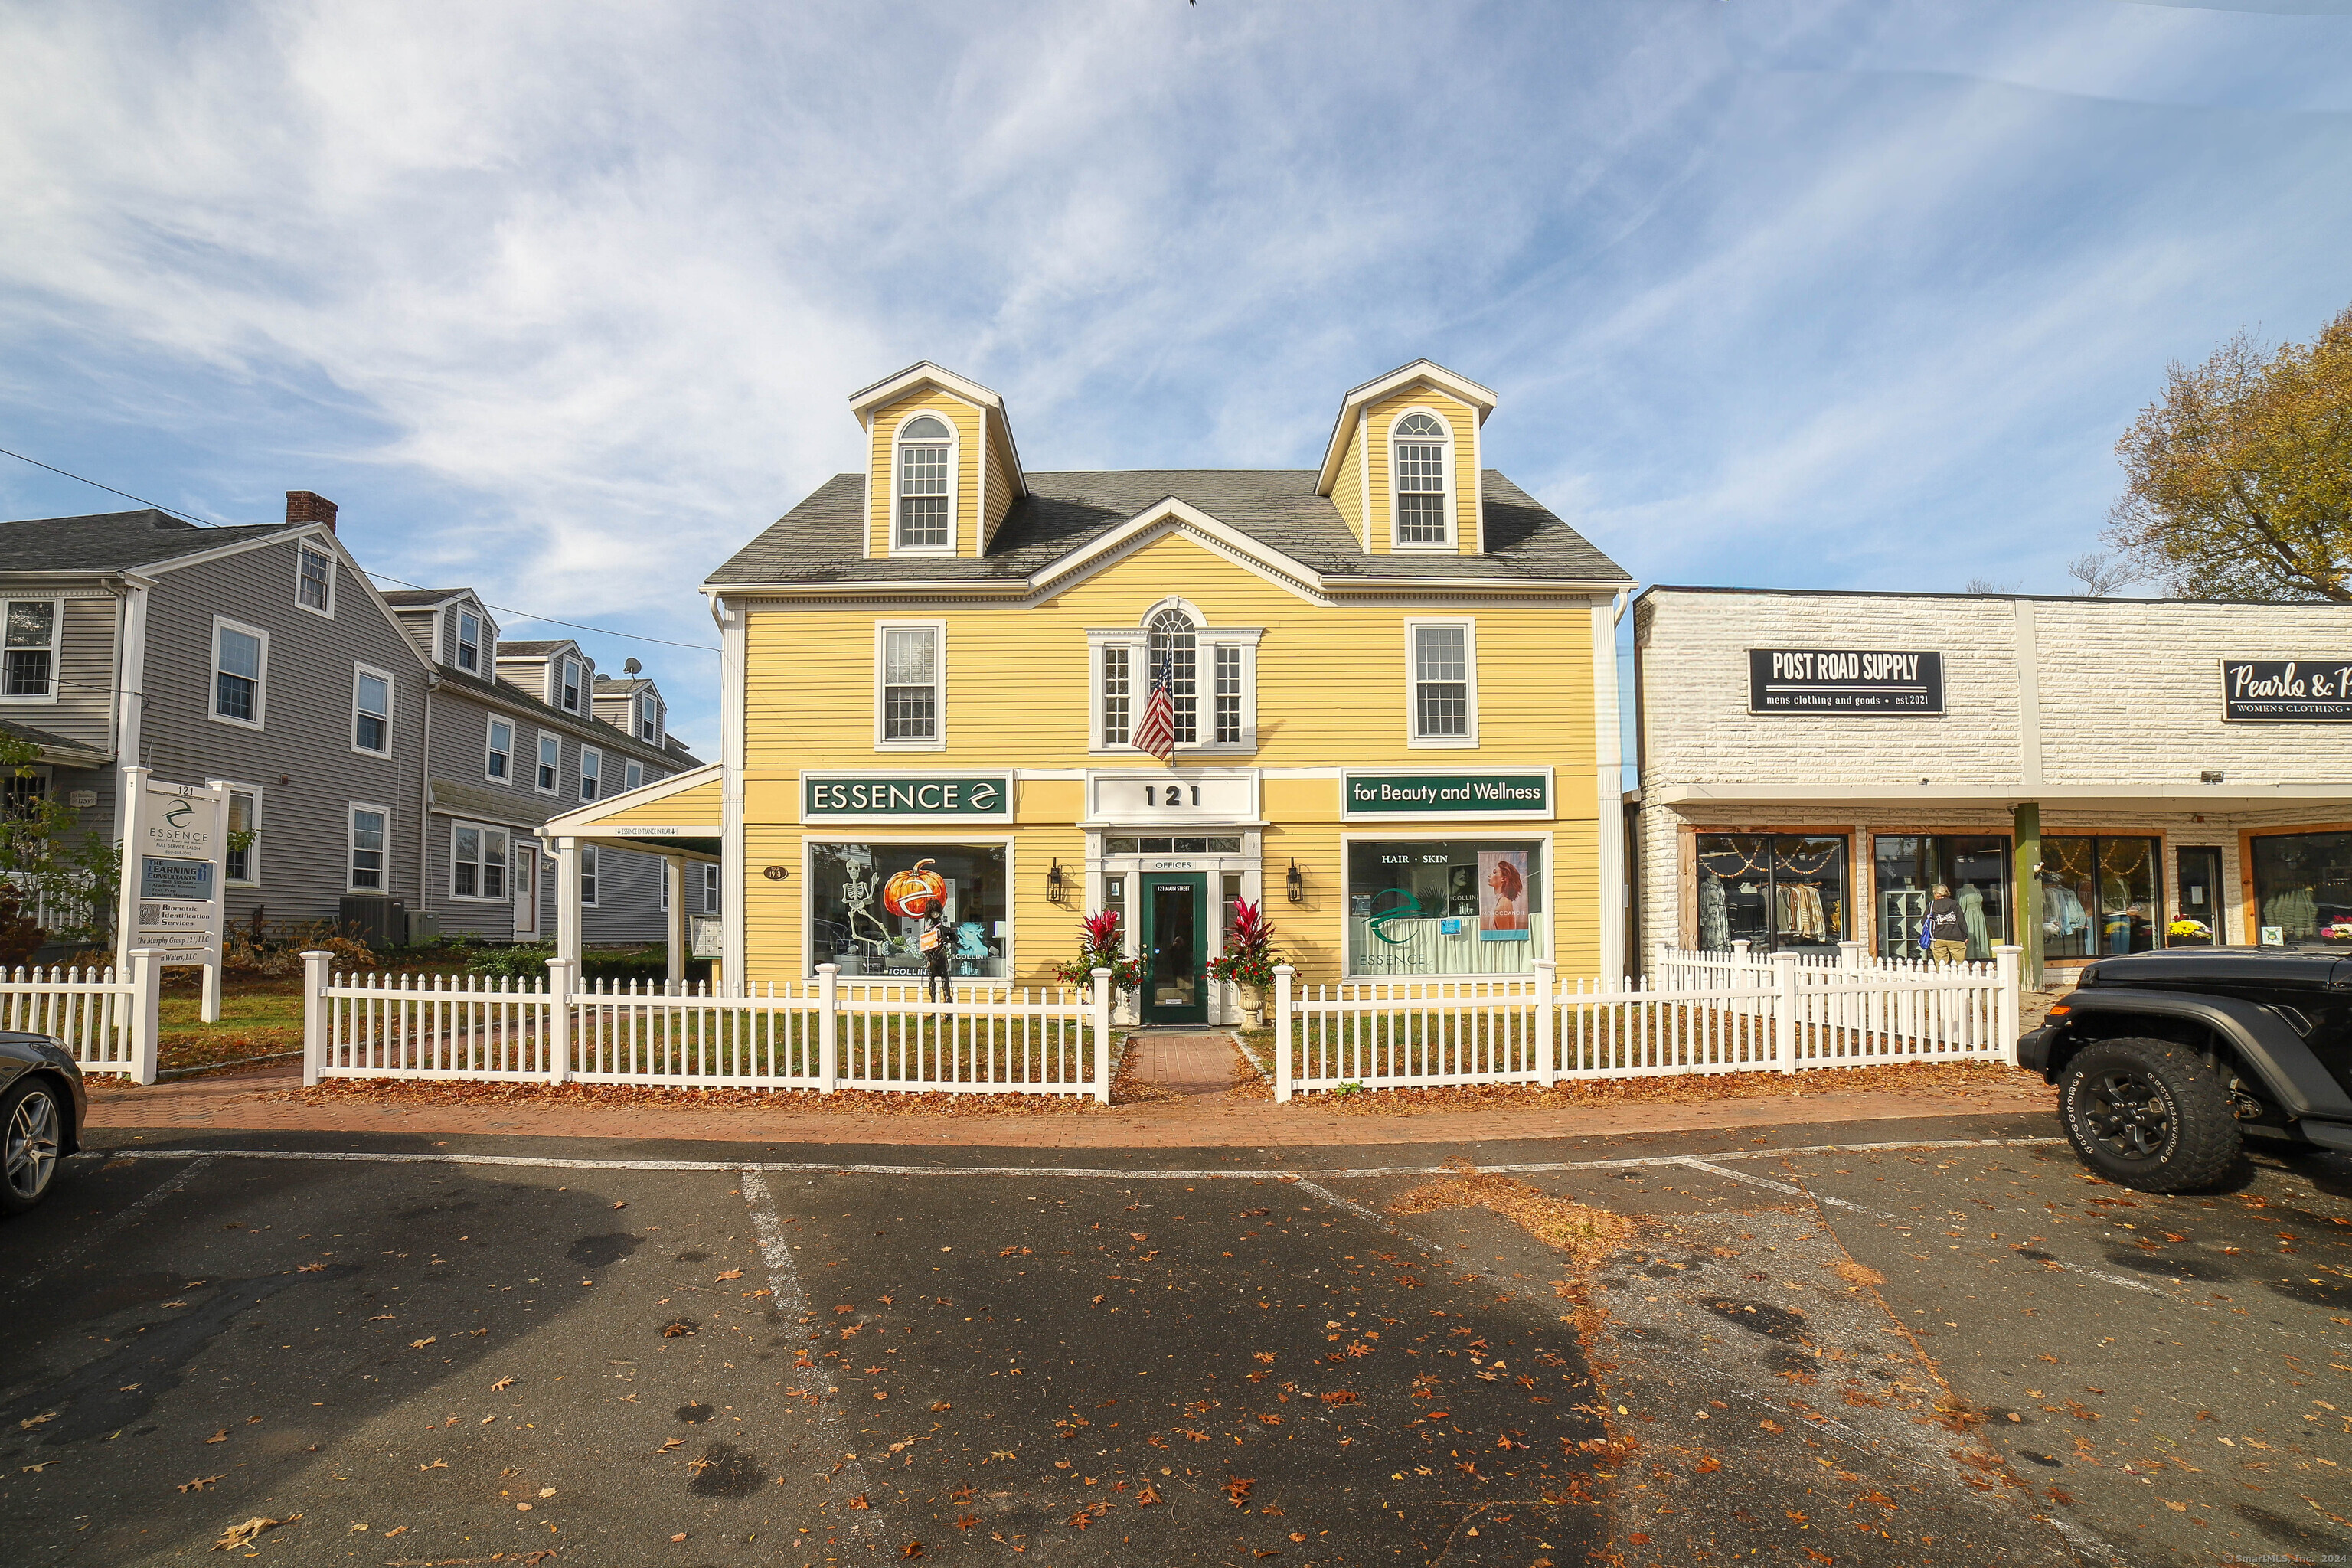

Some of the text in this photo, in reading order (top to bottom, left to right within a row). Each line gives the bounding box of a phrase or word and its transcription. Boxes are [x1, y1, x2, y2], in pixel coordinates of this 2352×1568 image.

[1772, 652, 1919, 681] POST ROAD SUPPLY
[2230, 662, 2307, 698] Pearls
[2311, 673, 2334, 697] &
[1766, 696, 1791, 705] mens
[1793, 694, 1832, 707] clothing
[1834, 695, 1852, 705] and
[1854, 695, 1880, 707] goods
[2236, 704, 2344, 714] WOMENS CLOTHING
[178, 786, 193, 795] 121
[813, 783, 959, 809] ESSENCE
[1145, 786, 1200, 806] 121
[1353, 782, 1541, 804] for Beauty and Wellness
[149, 828, 208, 842] ESSENCE
[1381, 854, 1449, 864] HAIR SKIN
[148, 865, 197, 875] LEARNING
[147, 872, 197, 881] CONSULTANTS
[162, 903, 198, 912] Biometric
[162, 911, 210, 920] Identification
[147, 936, 168, 946] Murphy
[168, 935, 185, 946] Group
[1360, 954, 1425, 965] ESSENCE
[2147, 1072, 2179, 1158] DESTINATION
